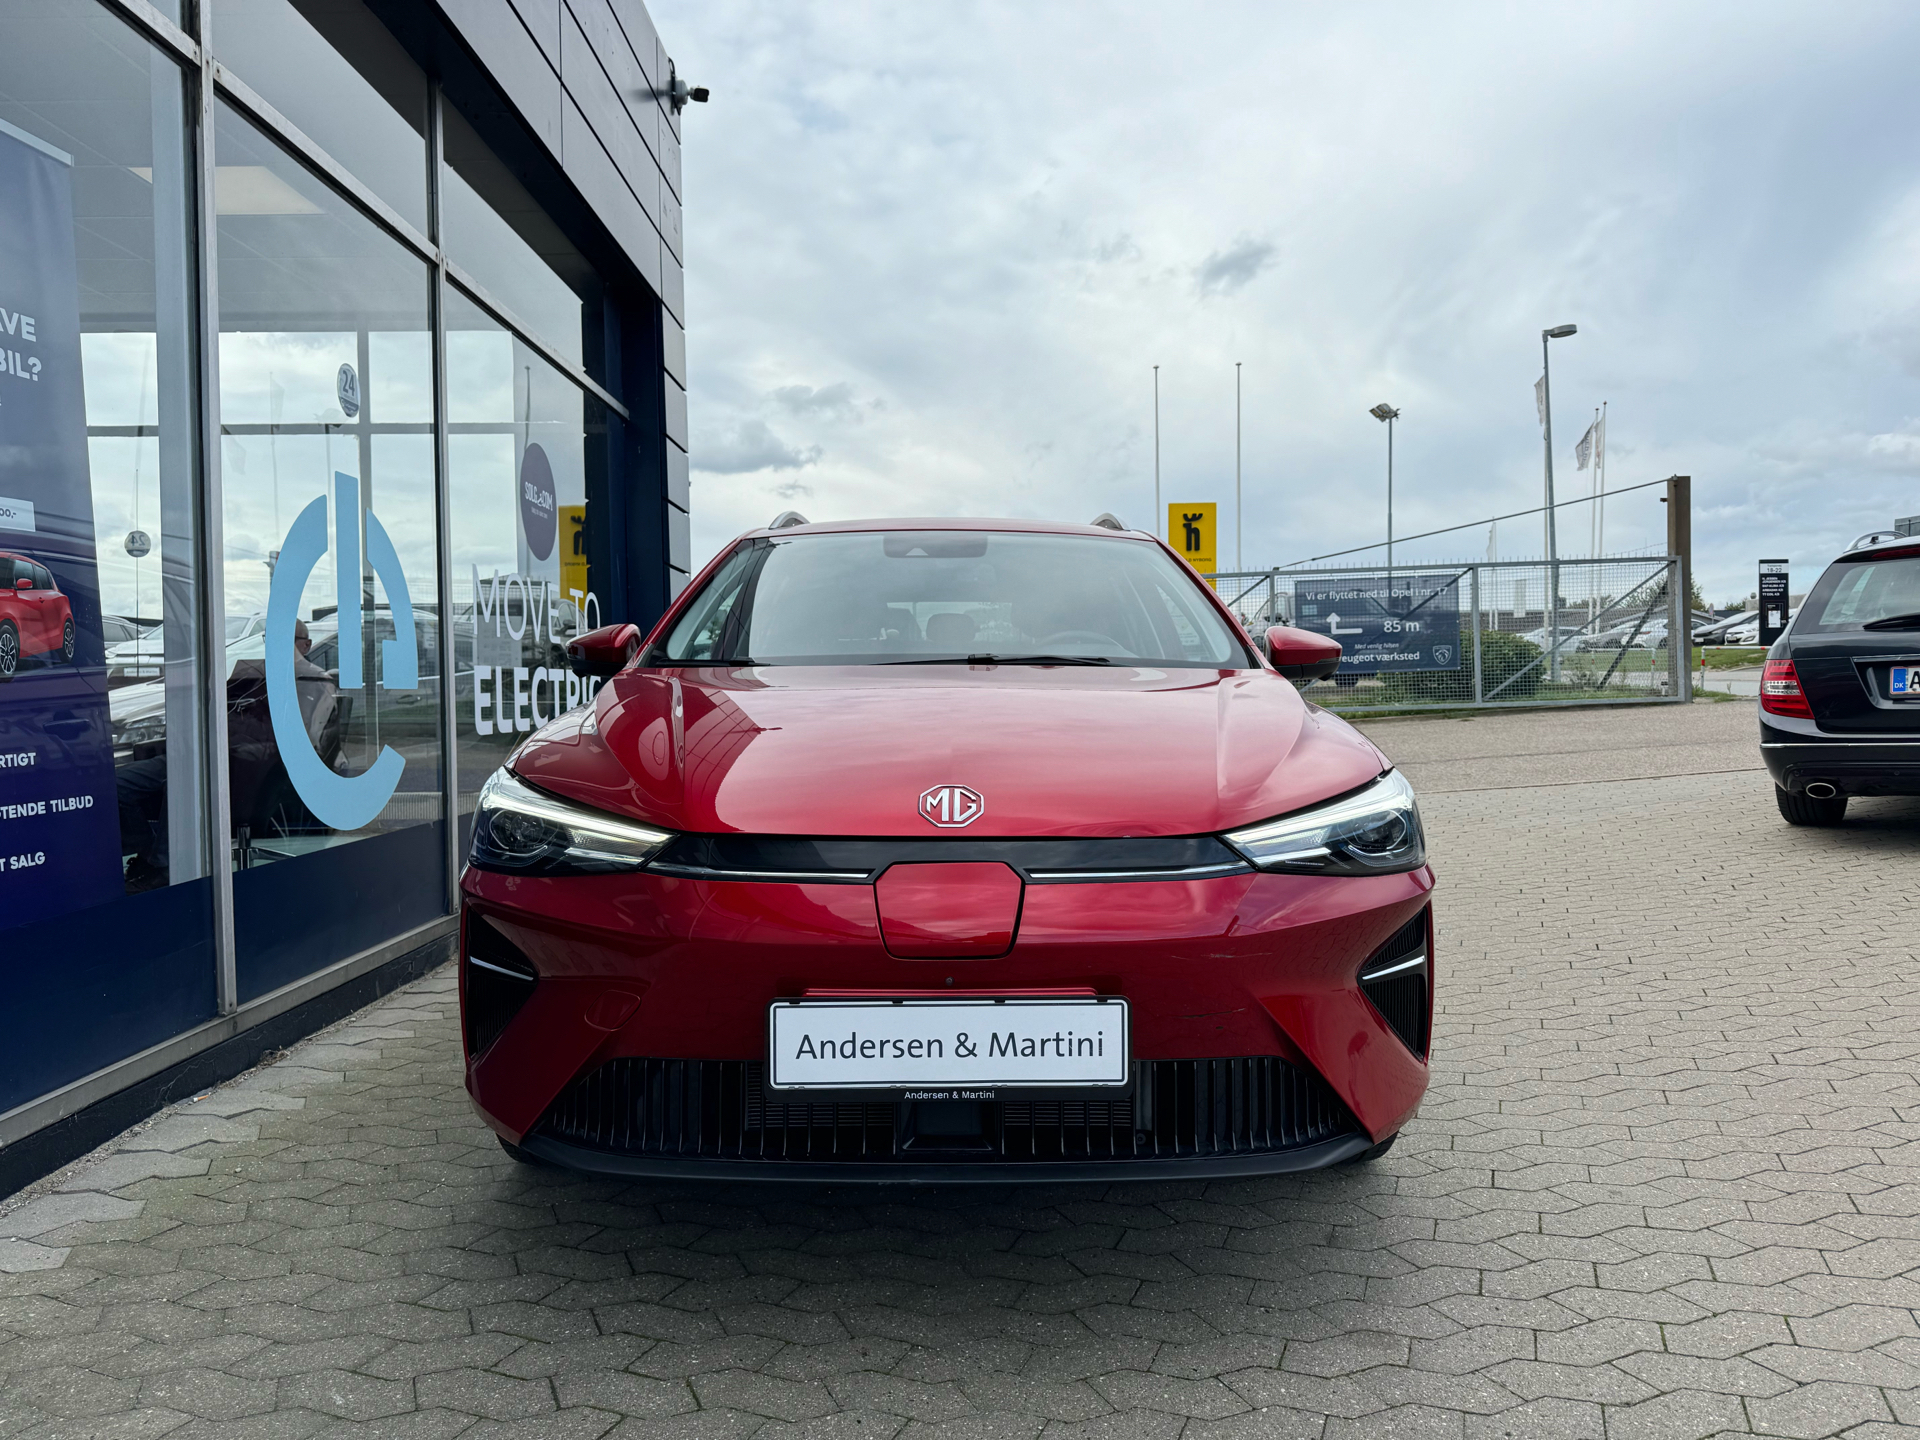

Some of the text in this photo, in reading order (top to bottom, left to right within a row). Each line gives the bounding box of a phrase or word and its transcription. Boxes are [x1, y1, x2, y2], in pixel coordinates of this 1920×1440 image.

[0, 307, 37, 343] VE
[342, 369, 355, 397] 24
[472, 563, 600, 644] MOVE TO
[1305, 592, 1315, 600] Vi
[1329, 591, 1358, 602] flyttet
[1359, 589, 1377, 598] ned
[1379, 589, 1389, 598] til
[1391, 588, 1413, 599] Opel
[1421, 588, 1434, 596] nr.
[1383, 620, 1420, 633] 85 m
[1341, 651, 1420, 664] eugeot værksted
[0, 795, 94, 819] TENDE TILBUD
[925, 788, 978, 822] MG
[10, 851, 46, 870] SALG
[796, 1030, 1103, 1060] Andersen & Martini
[904, 1090, 995, 1099] Andersen & Martini
